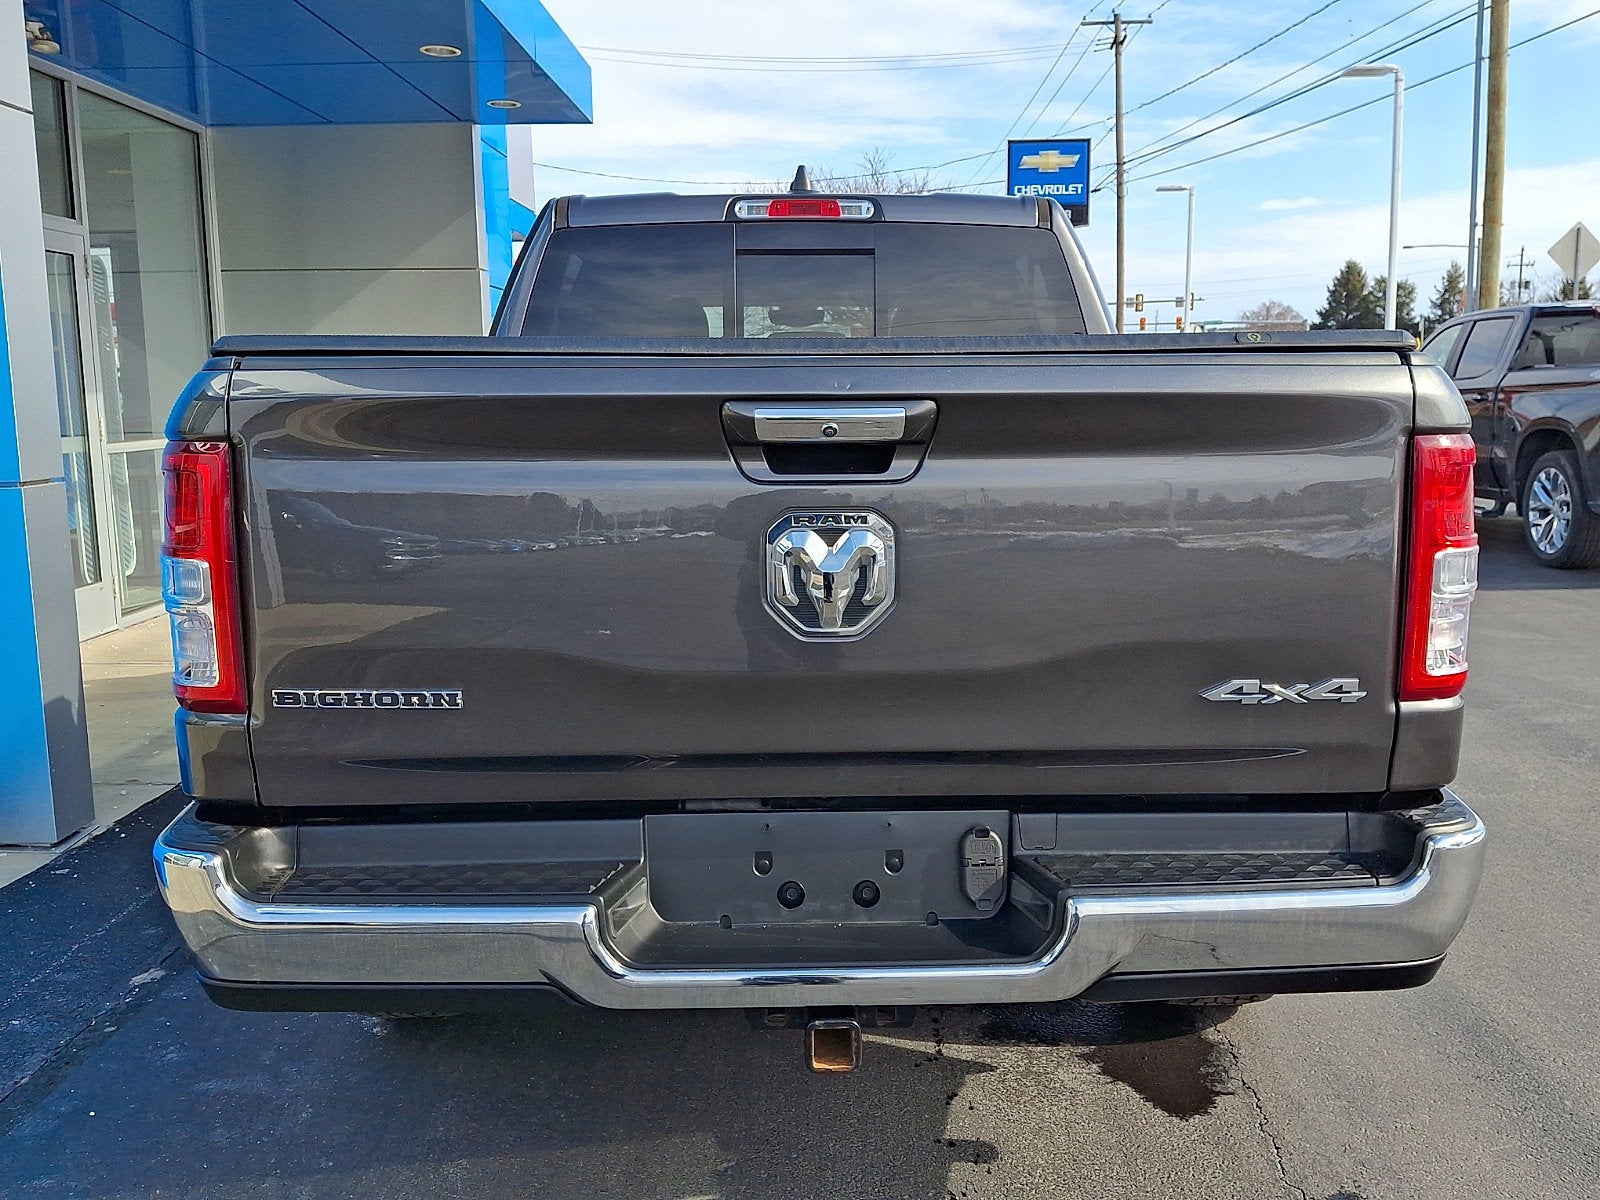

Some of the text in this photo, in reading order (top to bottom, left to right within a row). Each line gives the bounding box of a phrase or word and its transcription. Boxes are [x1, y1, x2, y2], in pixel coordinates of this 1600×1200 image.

[1014, 184, 1083, 196] CHEVROLET
[791, 514, 869, 526] RAM
[272, 688, 464, 709] BIGHORN
